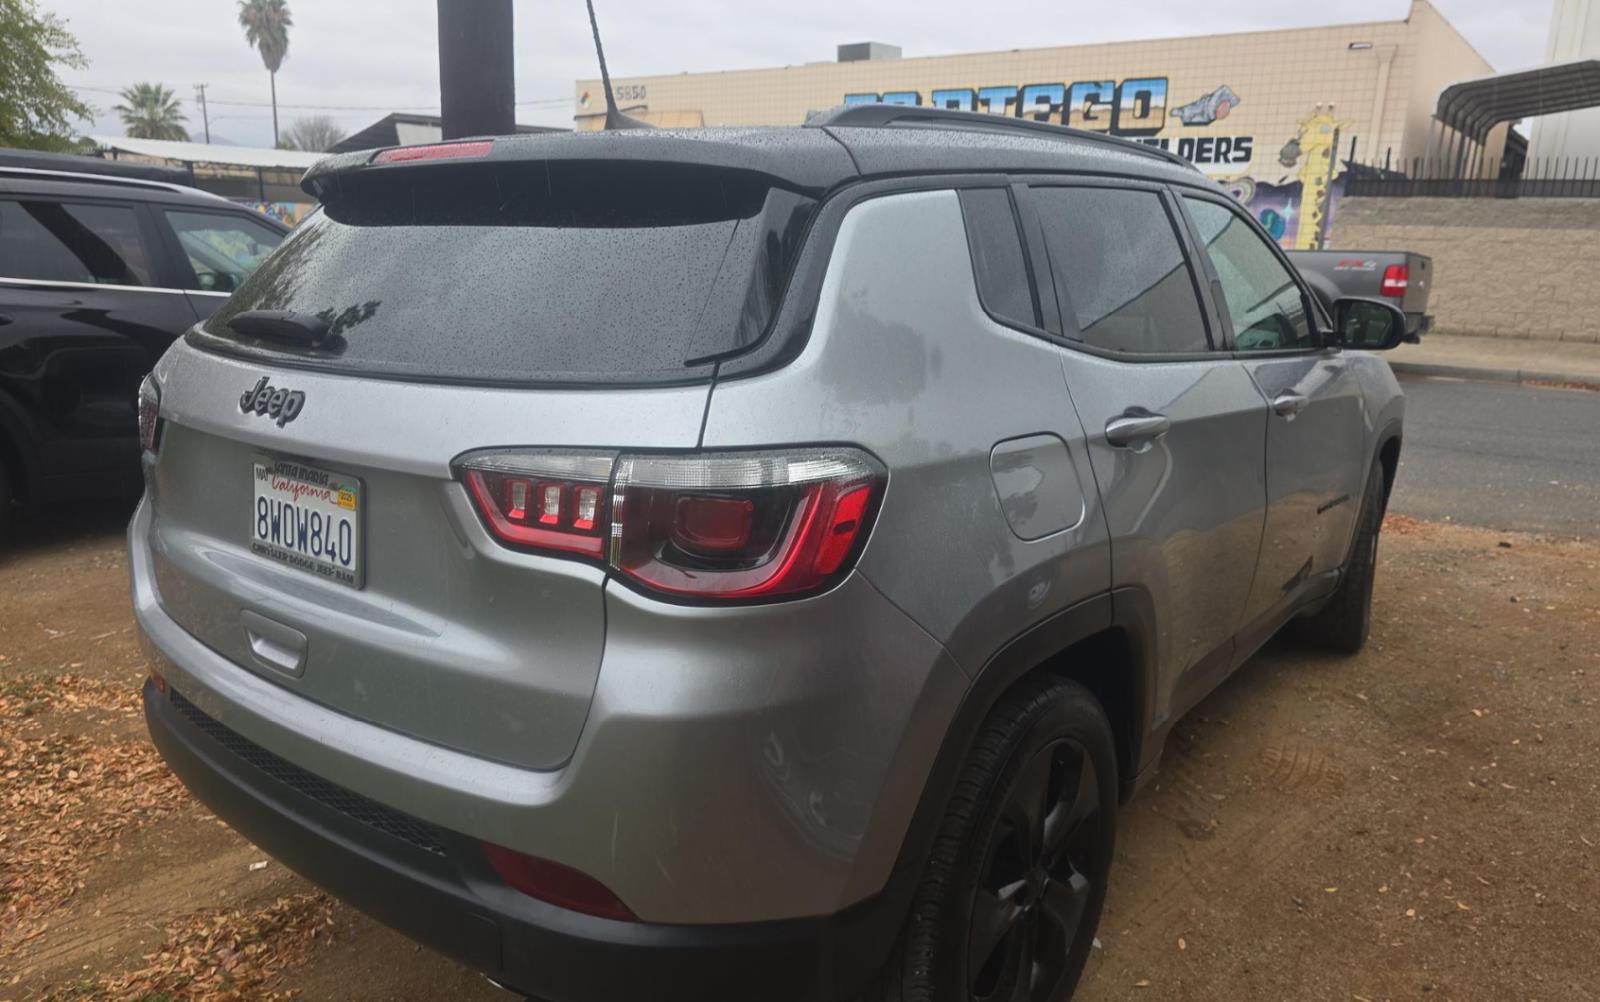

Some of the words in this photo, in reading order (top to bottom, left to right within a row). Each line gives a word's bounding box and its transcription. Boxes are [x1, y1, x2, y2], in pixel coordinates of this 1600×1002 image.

[844, 76, 1169, 137] TEGO
[1136, 136, 1253, 163] DERS
[240, 376, 306, 429] Jeep
[271, 474, 341, 504] California
[289, 554, 316, 572] DODGE
